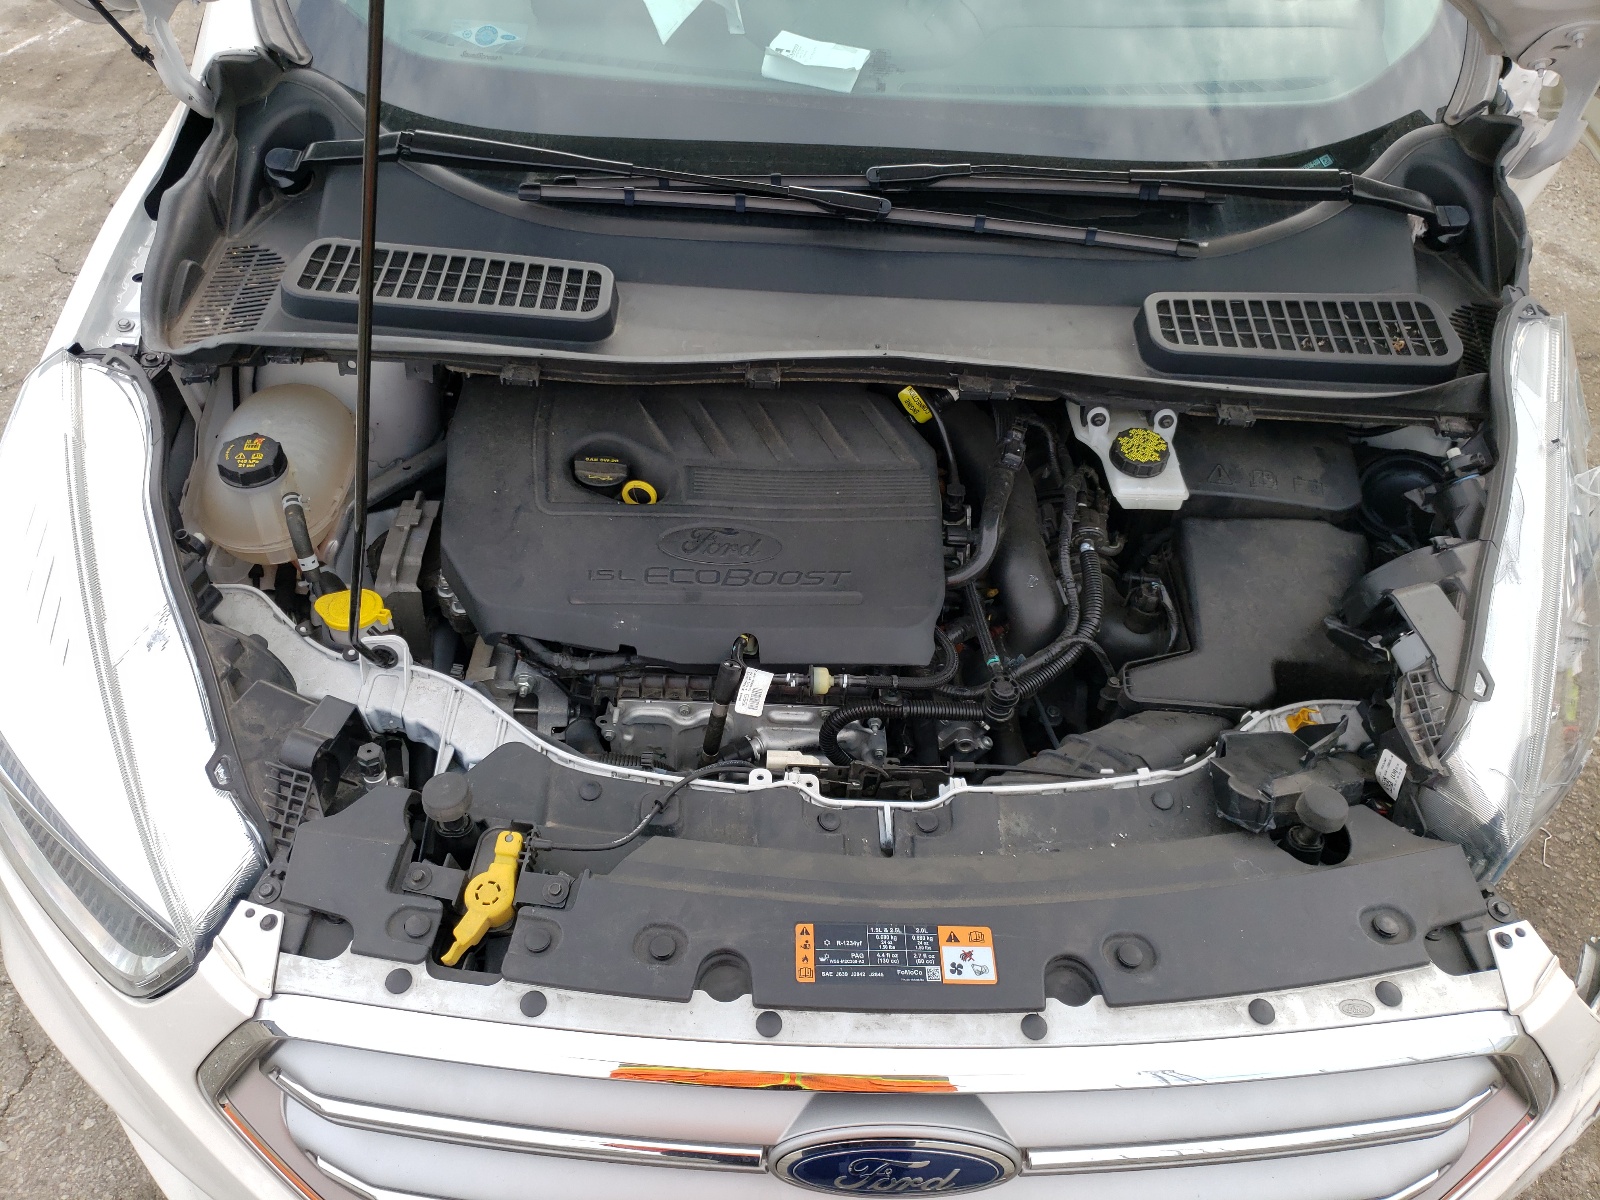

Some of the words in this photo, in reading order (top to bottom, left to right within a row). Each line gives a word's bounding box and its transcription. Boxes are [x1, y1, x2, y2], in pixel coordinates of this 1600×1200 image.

[904, 398, 920, 415] ENGINE
[681, 526, 762, 557] Ford
[833, 1157, 960, 1191] Ford
